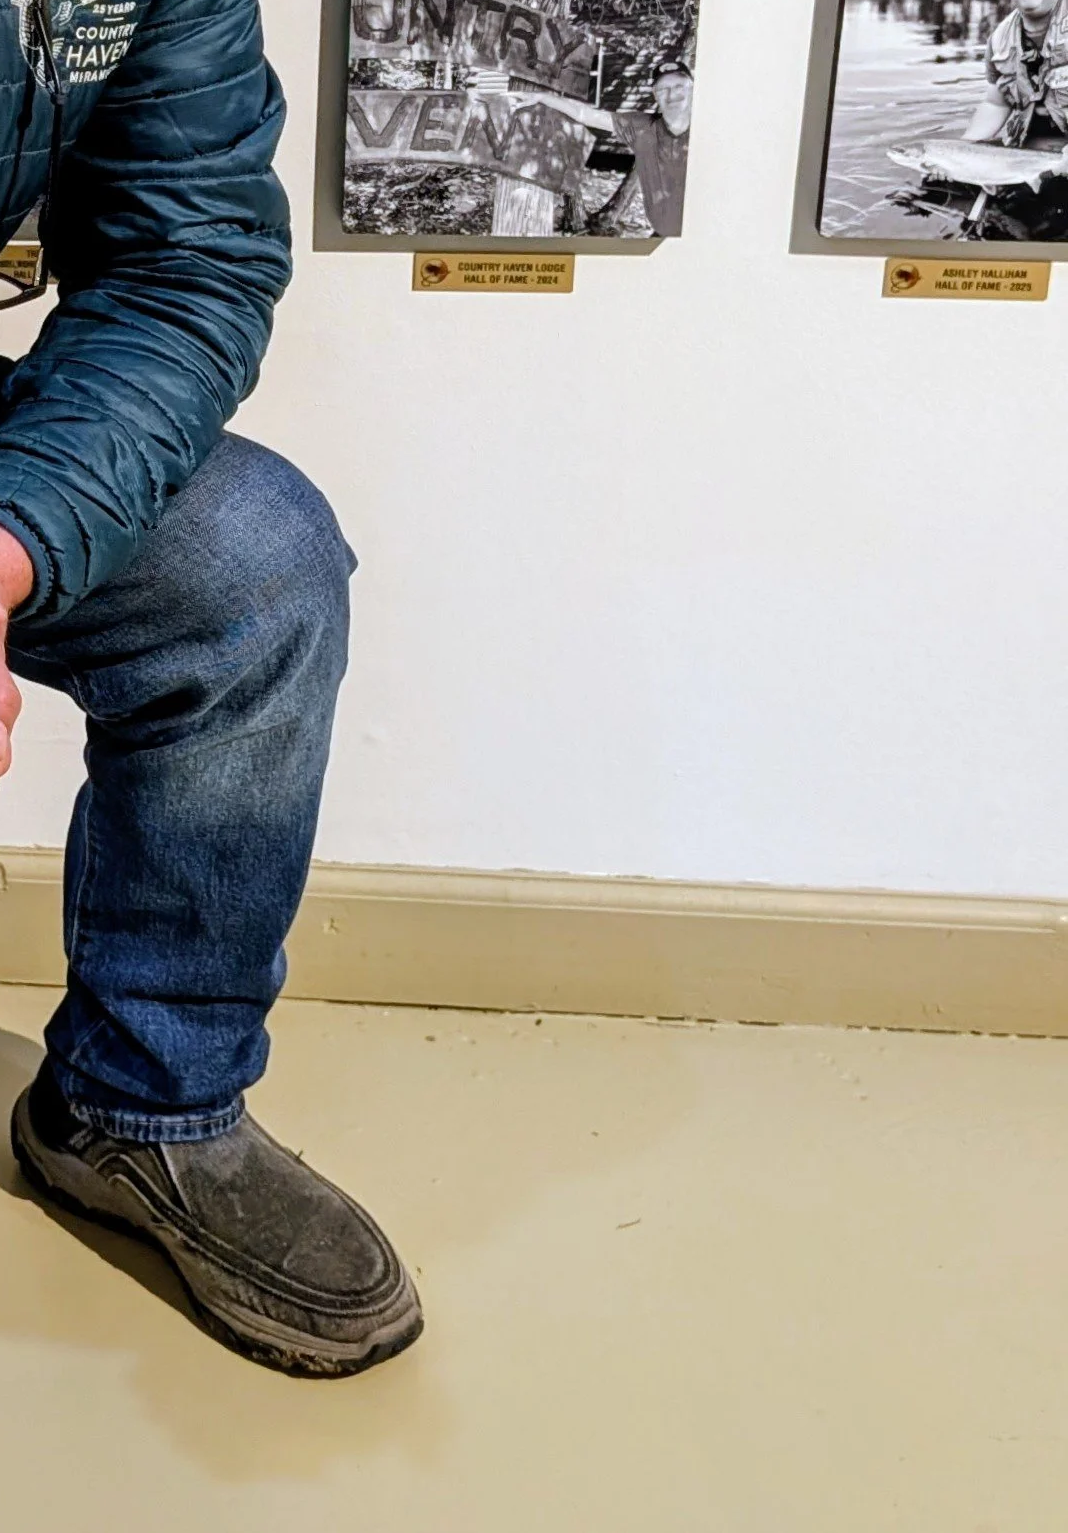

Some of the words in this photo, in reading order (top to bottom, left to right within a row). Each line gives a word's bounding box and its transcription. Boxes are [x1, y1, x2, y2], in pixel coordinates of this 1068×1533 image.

[93, 4, 105, 15] 25
[106, 1, 137, 15] YEARS
[75, 22, 138, 40] COUNTRY
[66, 38, 133, 68] HAVEN
[458, 262, 500, 272] COUNTRY
[503, 262, 532, 272] HAVEN
[535, 263, 565, 273] LODGE
[942, 268, 978, 278] ASHLEY
[464, 275, 486, 284] HALL
[489, 275, 500, 284] OF
[504, 275, 528, 285] FAME
[537, 276, 558, 285] 2024
[935, 281, 958, 291] HALL
[961, 281, 973, 291] OF
[976, 281, 1001, 291] FAME
